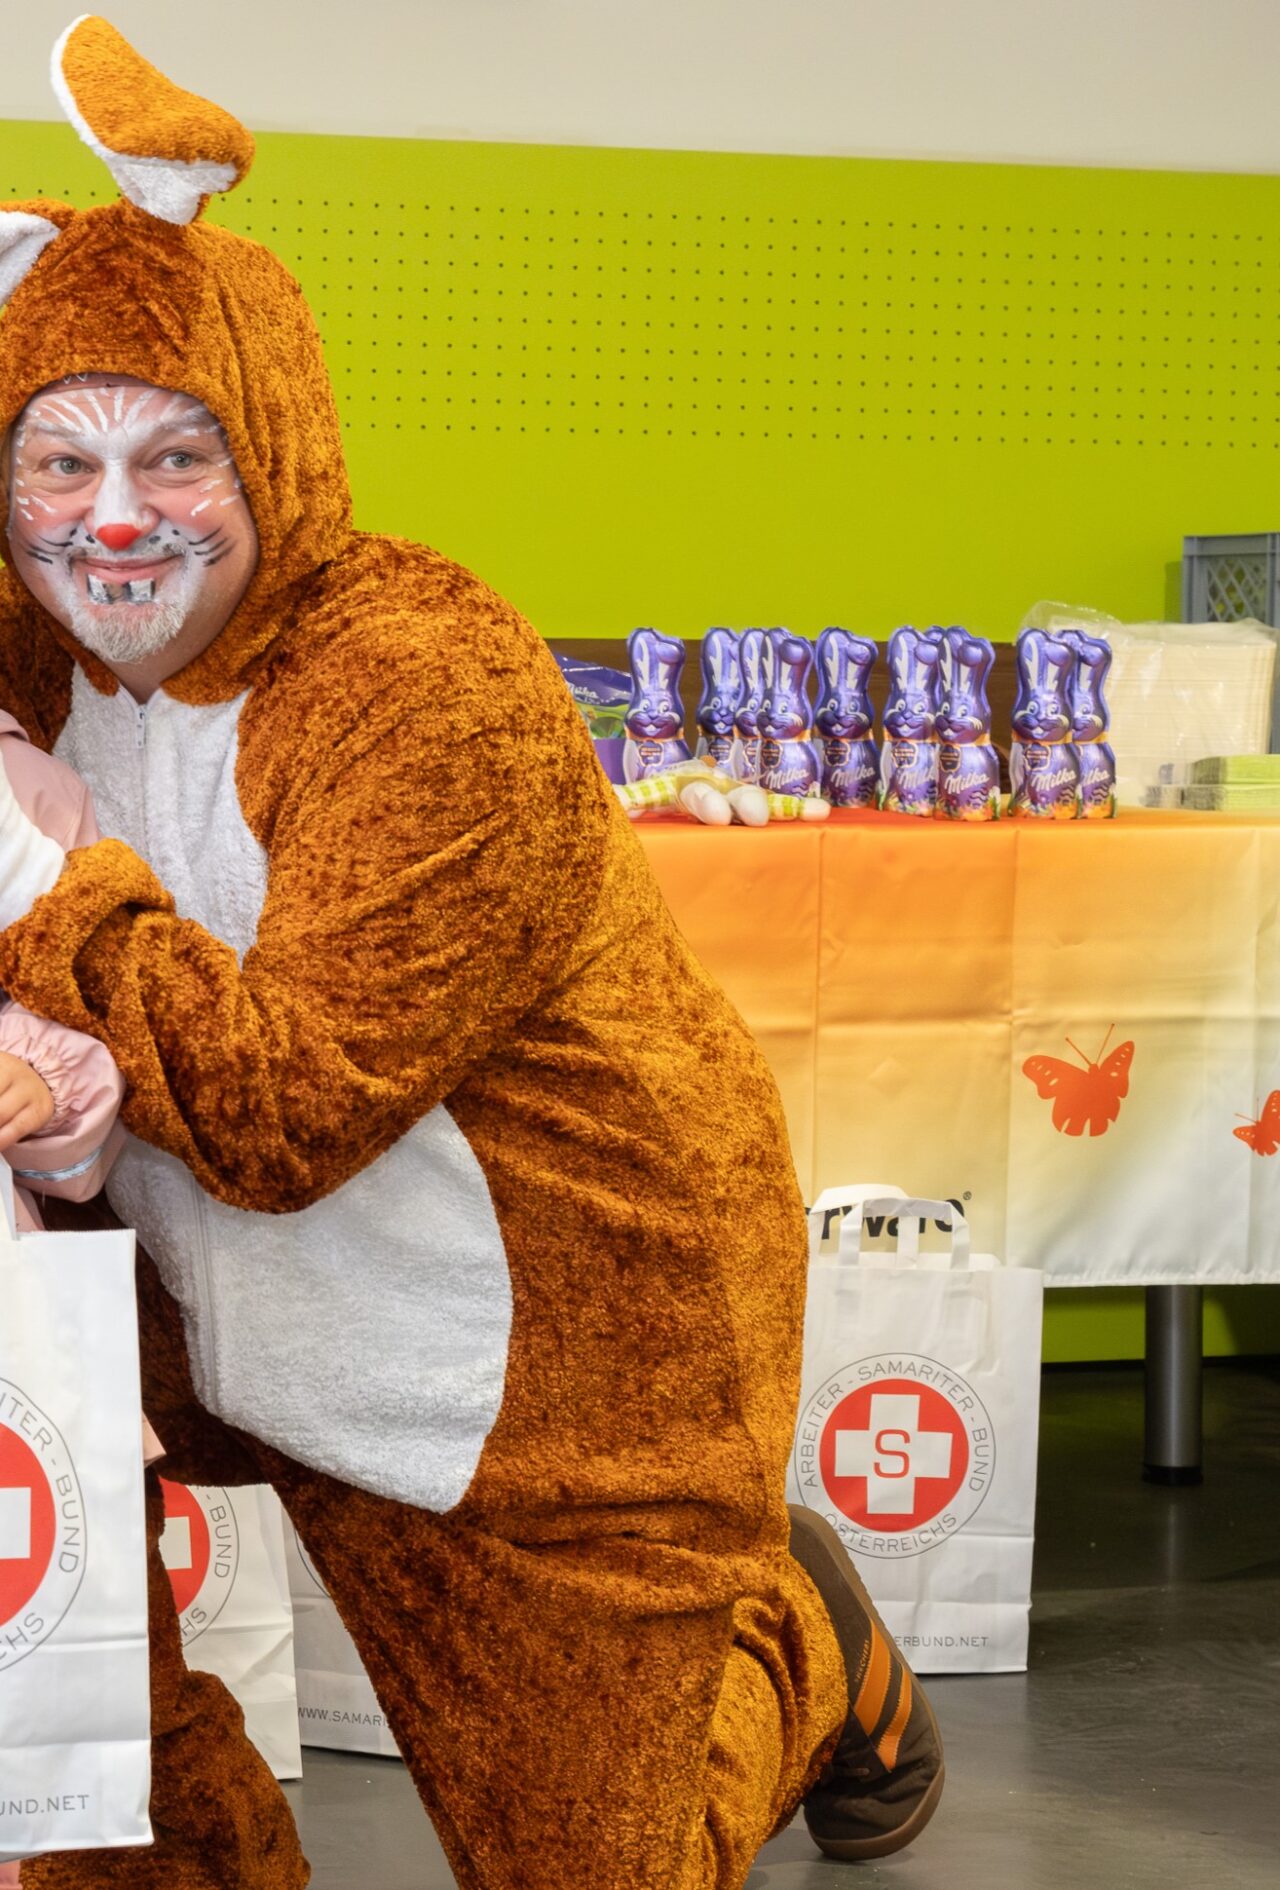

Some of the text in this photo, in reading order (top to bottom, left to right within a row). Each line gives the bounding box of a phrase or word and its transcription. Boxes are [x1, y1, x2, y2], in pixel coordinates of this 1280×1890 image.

[766, 768, 809, 790] Milka
[830, 765, 876, 788] Milka
[944, 772, 991, 795] Milka
[1030, 767, 1078, 792] Milka
[801, 1382, 844, 1488] ARBEITER
[858, 1360, 974, 1412] SAMARITER
[968, 1427, 990, 1492] BUND
[873, 1428, 911, 1479] S
[55, 1474, 81, 1574] BUND
[209, 1505, 233, 1578] BUND
